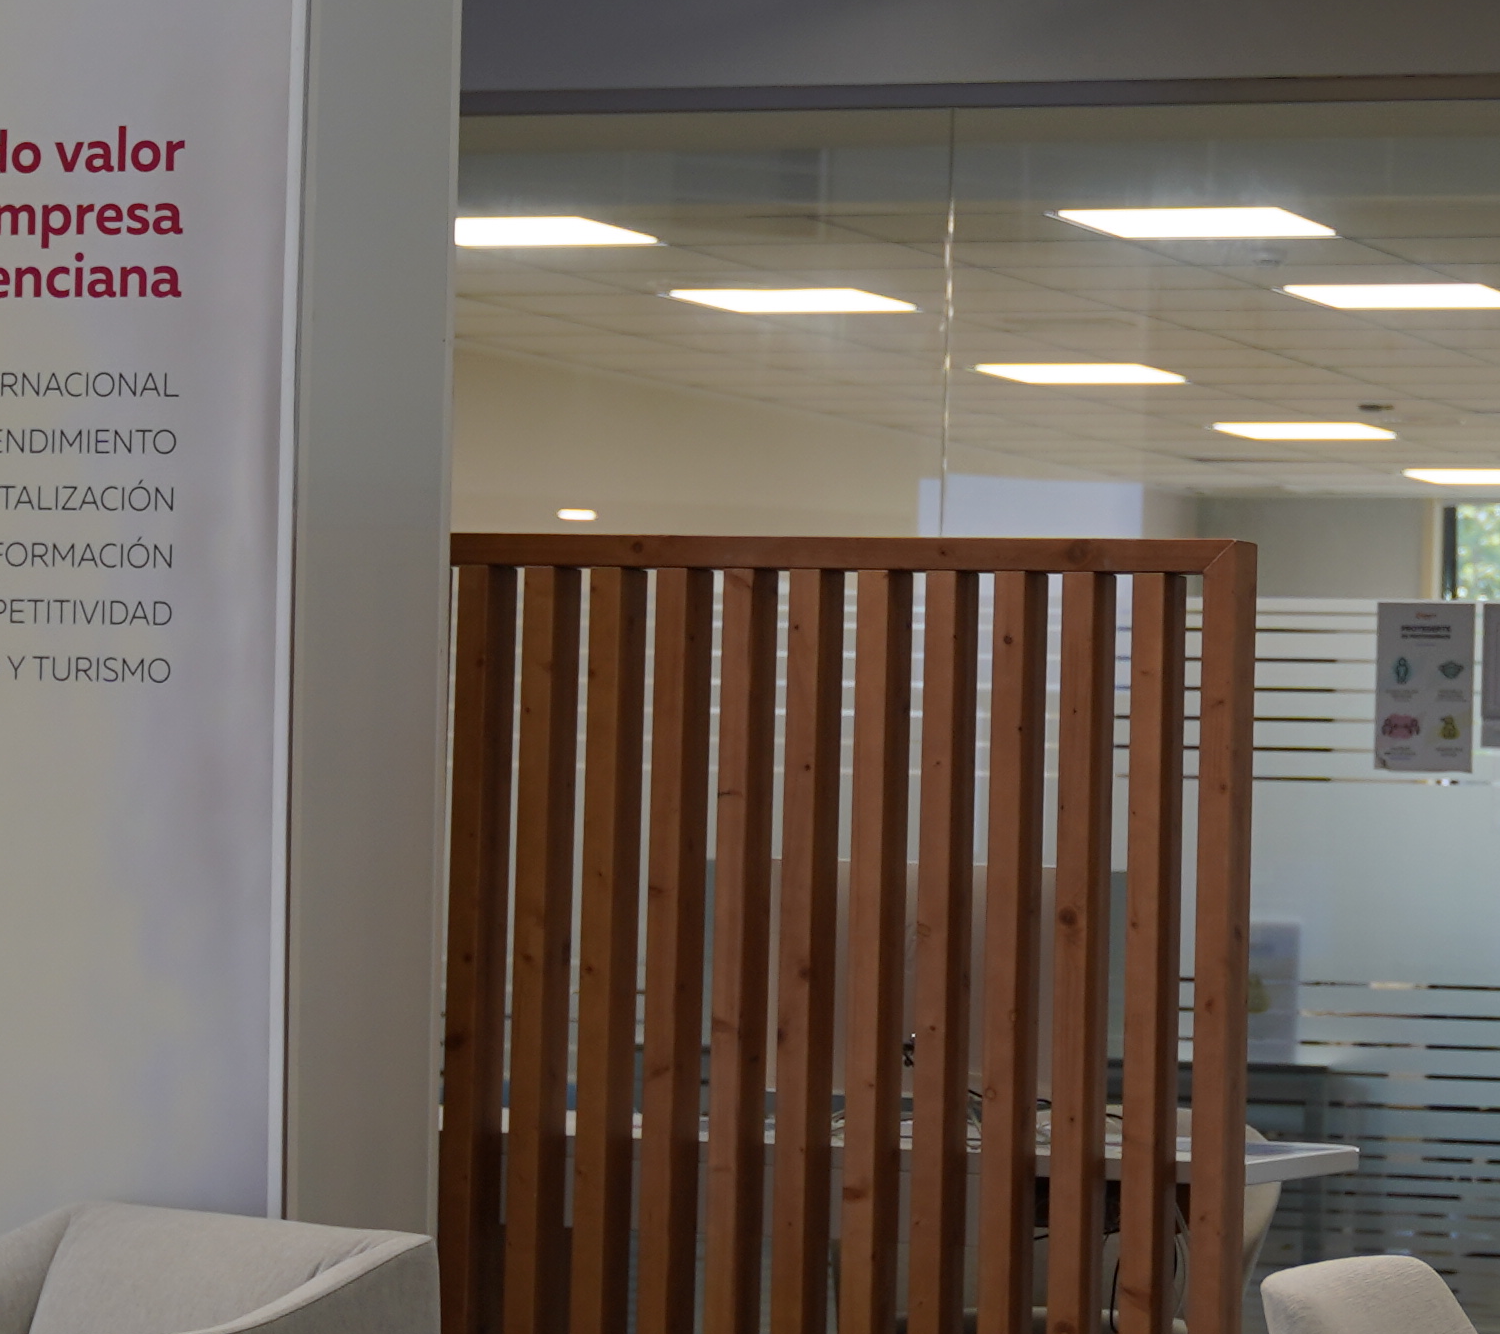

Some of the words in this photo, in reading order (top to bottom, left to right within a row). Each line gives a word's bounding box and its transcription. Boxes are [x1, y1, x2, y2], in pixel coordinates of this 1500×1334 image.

[55, 126, 186, 174] valor
[9, 656, 26, 680] Y
[35, 656, 172, 684] TURISMO
